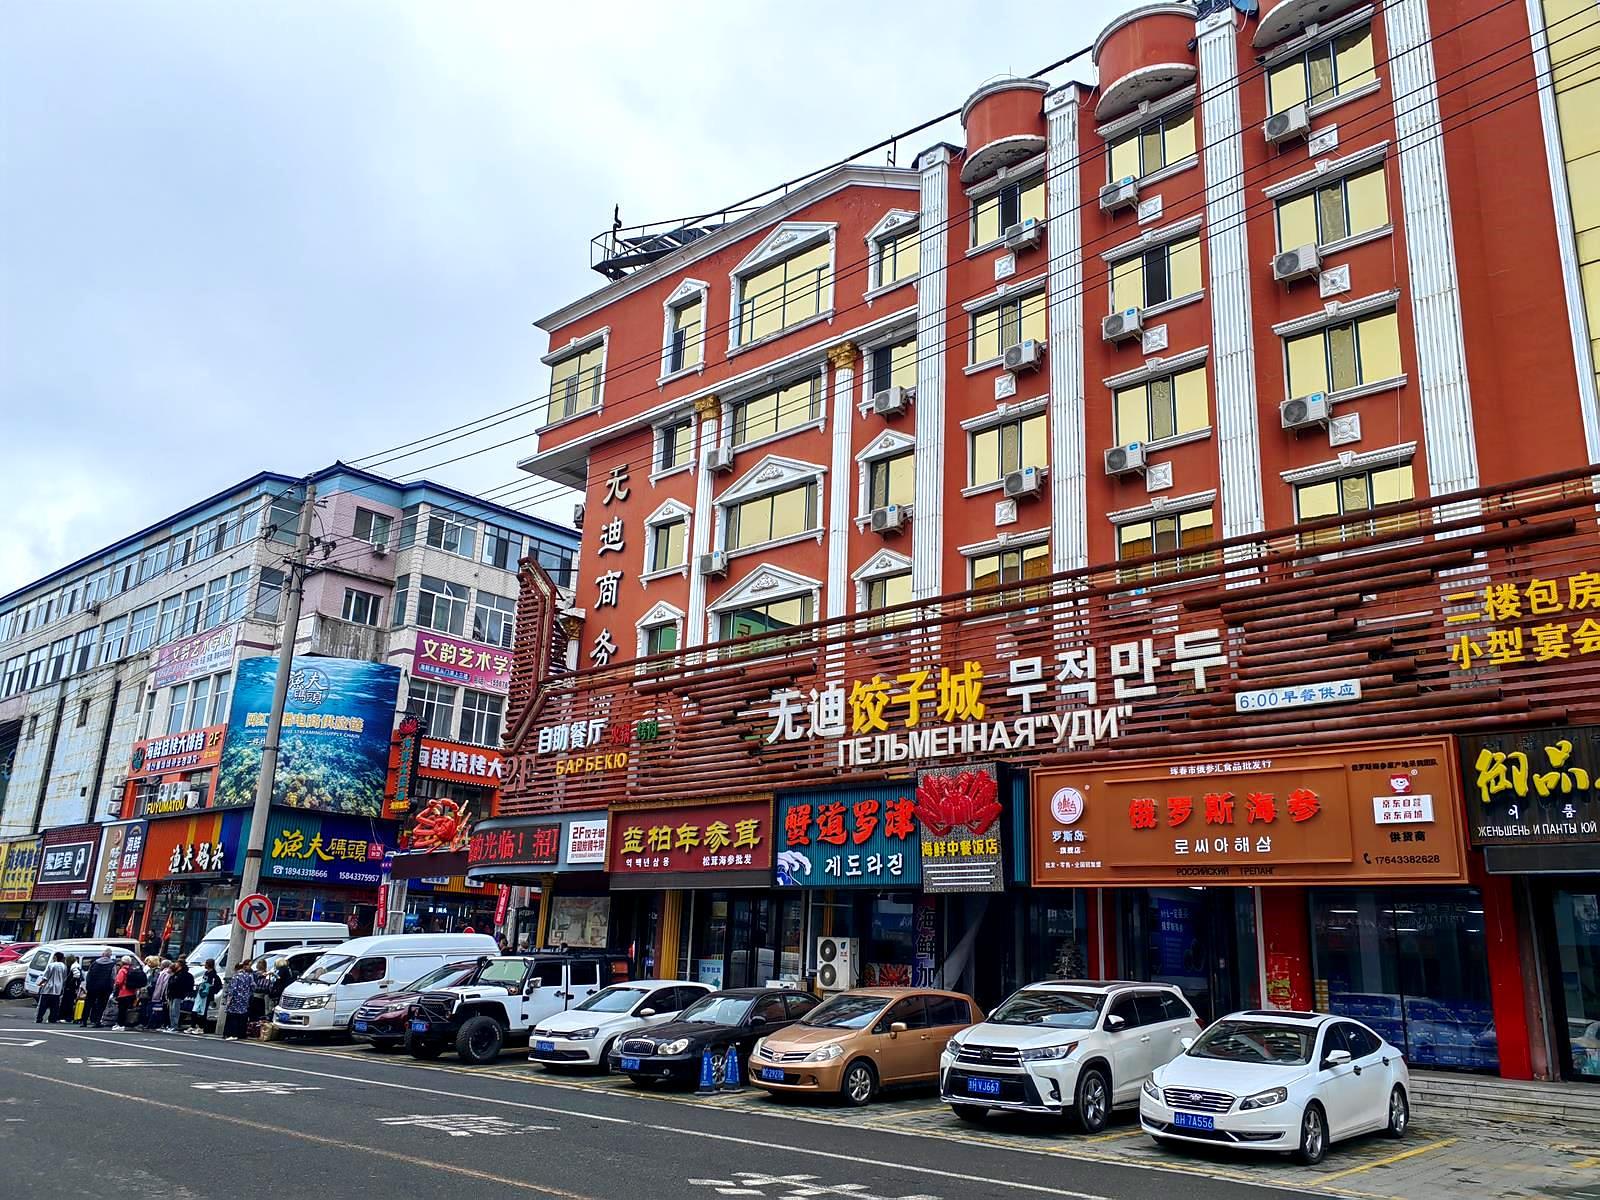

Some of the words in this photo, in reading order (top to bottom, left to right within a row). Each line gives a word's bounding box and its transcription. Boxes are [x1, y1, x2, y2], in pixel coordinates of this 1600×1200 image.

[590, 463, 630, 667] 无迪商务
[1446, 571, 1600, 622] 二楼包房
[420, 638, 514, 677] 文韵艺术学
[1451, 618, 1600, 671] 小型宴会
[1006, 628, 1229, 712] 무적만두
[245, 712, 364, 733] 网红播电商供应链
[538, 716, 609, 753] 自助餐厅
[208, 731, 220, 746] 2F
[555, 752, 628, 776] БАРБЕКЮ
[1475, 740, 1600, 803] 御品
[146, 799, 185, 815] FUYUMATOU
[1128, 788, 1321, 830] 俄罗斯海参
[1389, 831, 1426, 843] 供货商
[1478, 825, 1530, 836] ЖЕНЬШЕНЬ
[1533, 824, 1540, 834] И
[1543, 823, 1577, 835] ПАНТЫ
[168, 842, 224, 873] 渔夫码头
[271, 829, 368, 863] 漁夫碼頭
[921, 839, 998, 857] 海鲜中餐饭店
[1375, 854, 1440, 865] 17643382628
[285, 867, 328, 878] 18943318666
[824, 852, 903, 877] 게도라진
